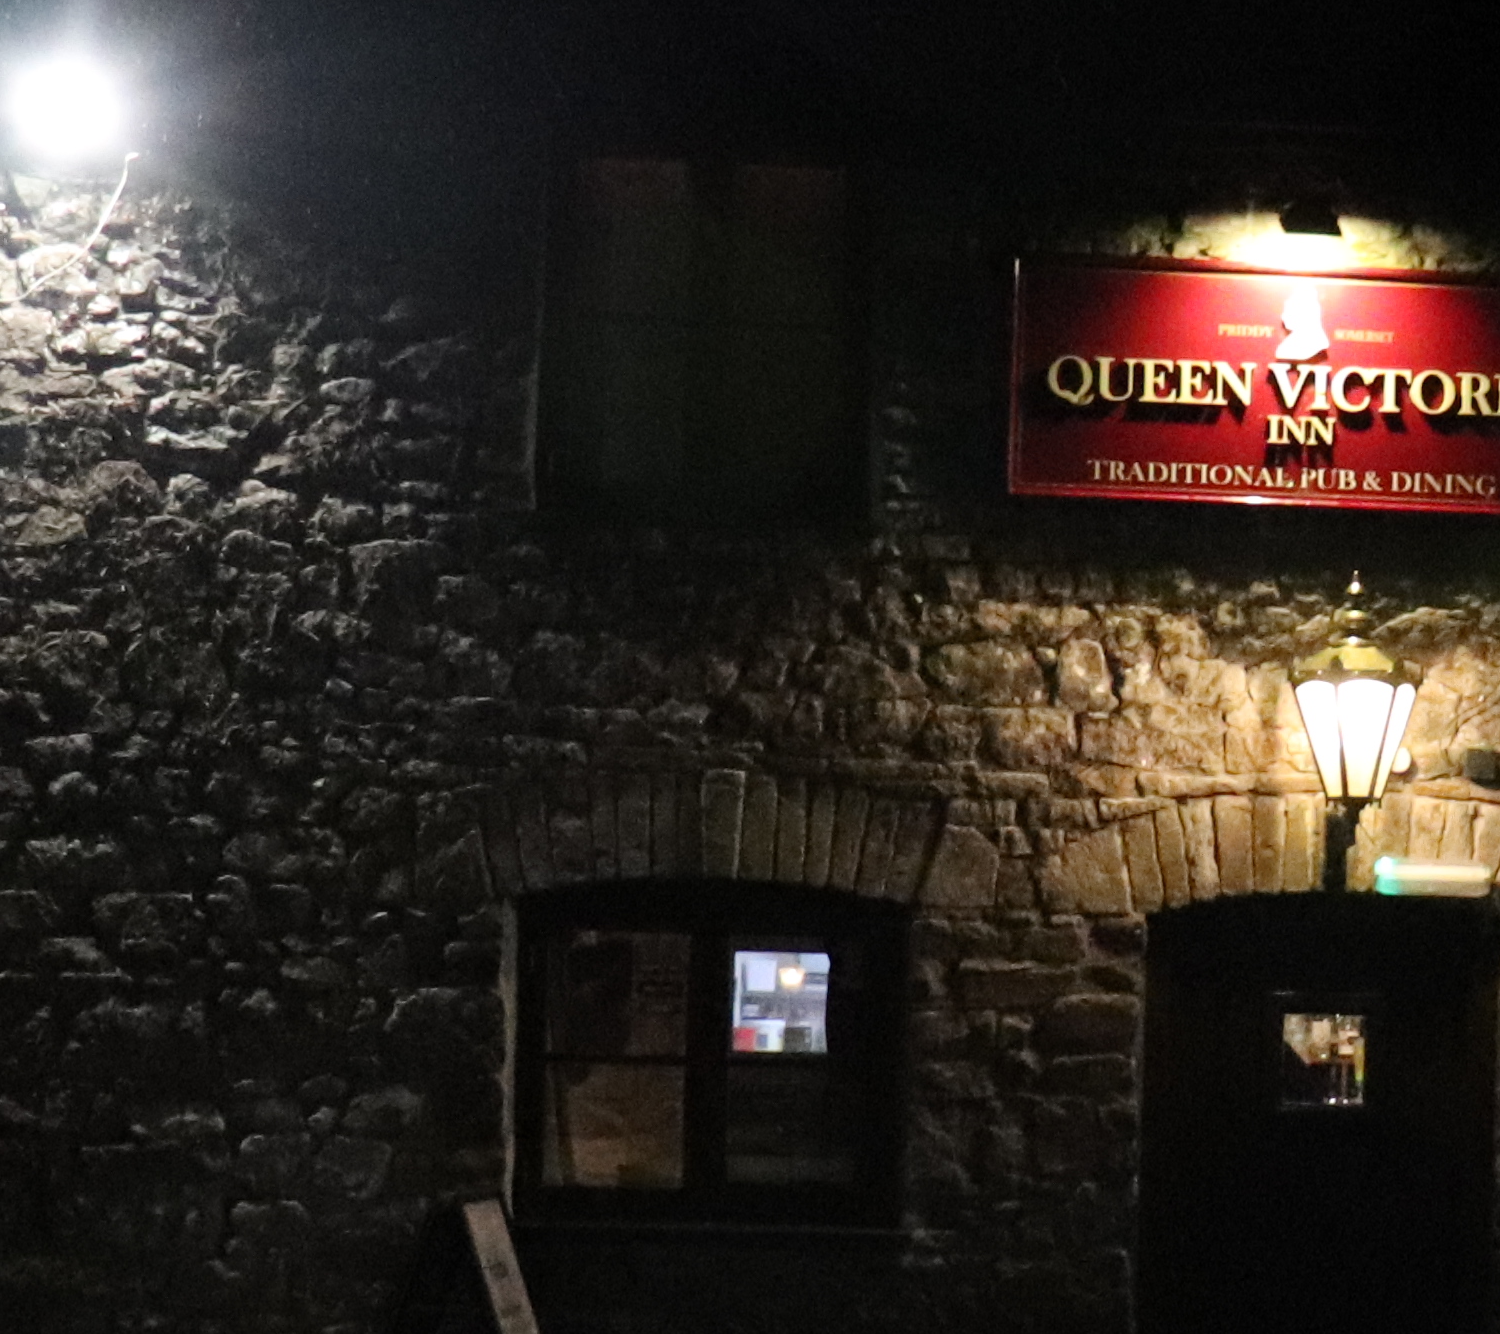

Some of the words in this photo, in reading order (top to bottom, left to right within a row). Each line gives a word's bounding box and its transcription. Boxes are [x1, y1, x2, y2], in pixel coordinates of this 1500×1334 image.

[1217, 323, 1275, 339] PRIDDY
[1048, 353, 1258, 407] QUEEN
[1266, 413, 1337, 447] INN
[1087, 458, 1296, 490] TRADITIONAL
[1300, 466, 1358, 492] PUB
[1362, 469, 1383, 493] &
[1390, 470, 1497, 497] DINING
